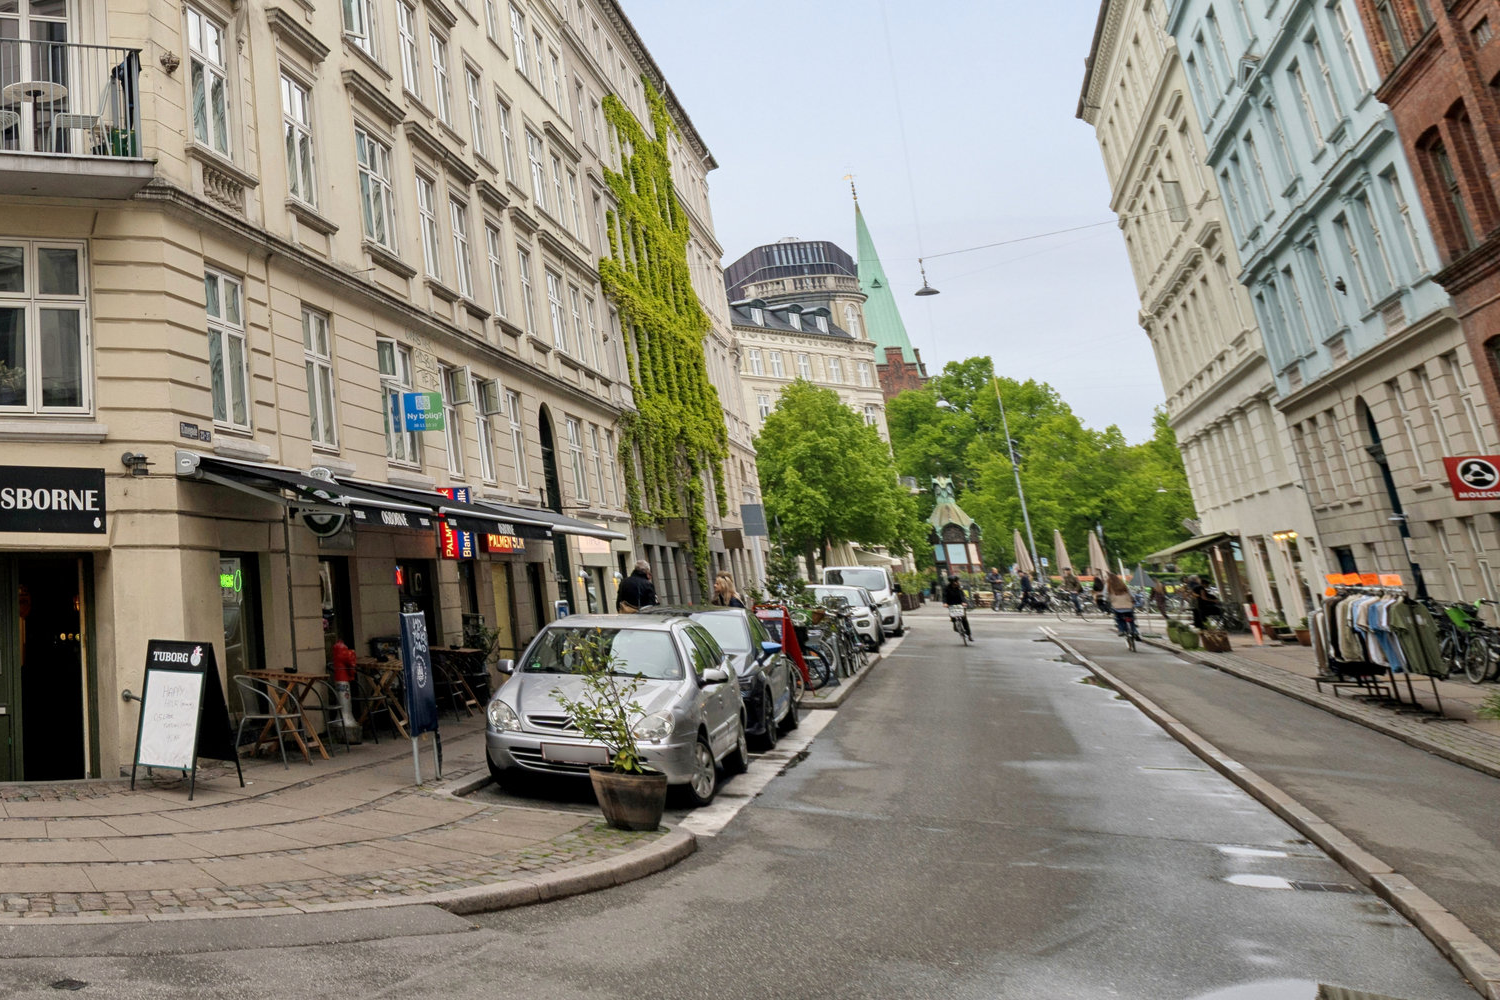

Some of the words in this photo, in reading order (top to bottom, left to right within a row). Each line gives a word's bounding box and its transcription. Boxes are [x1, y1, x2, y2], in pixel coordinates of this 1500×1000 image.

[407, 412, 418, 420] Ny
[419, 411, 442, 419] bolig?
[489, 533, 512, 548] PALMEN
[153, 651, 188, 663] TUBORG
